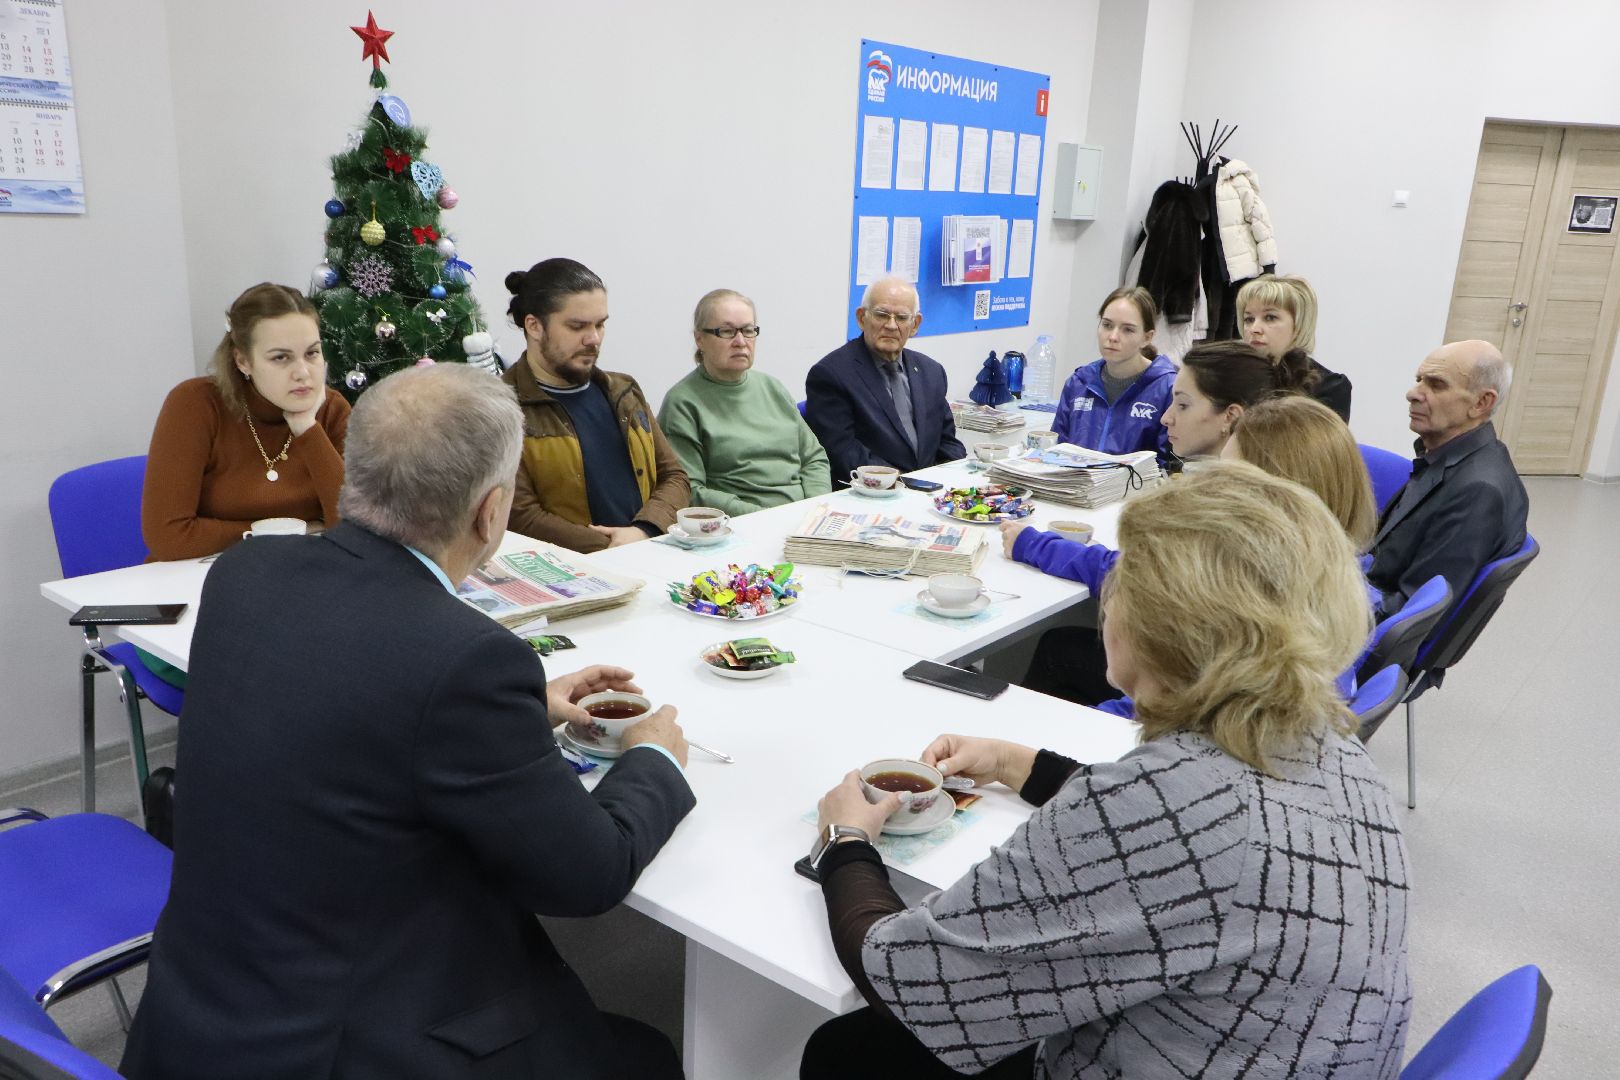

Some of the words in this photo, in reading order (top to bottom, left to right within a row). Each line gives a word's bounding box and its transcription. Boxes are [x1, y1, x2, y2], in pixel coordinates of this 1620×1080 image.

[20, 8, 51, 17] ДЕКАБРЬ
[1, 53, 11, 61] 20
[23, 55, 32, 63] 21
[3, 63, 12, 71] 27
[896, 64, 998, 102] ИНФОРМАЦИЯ
[36, 158, 46, 166] 25
